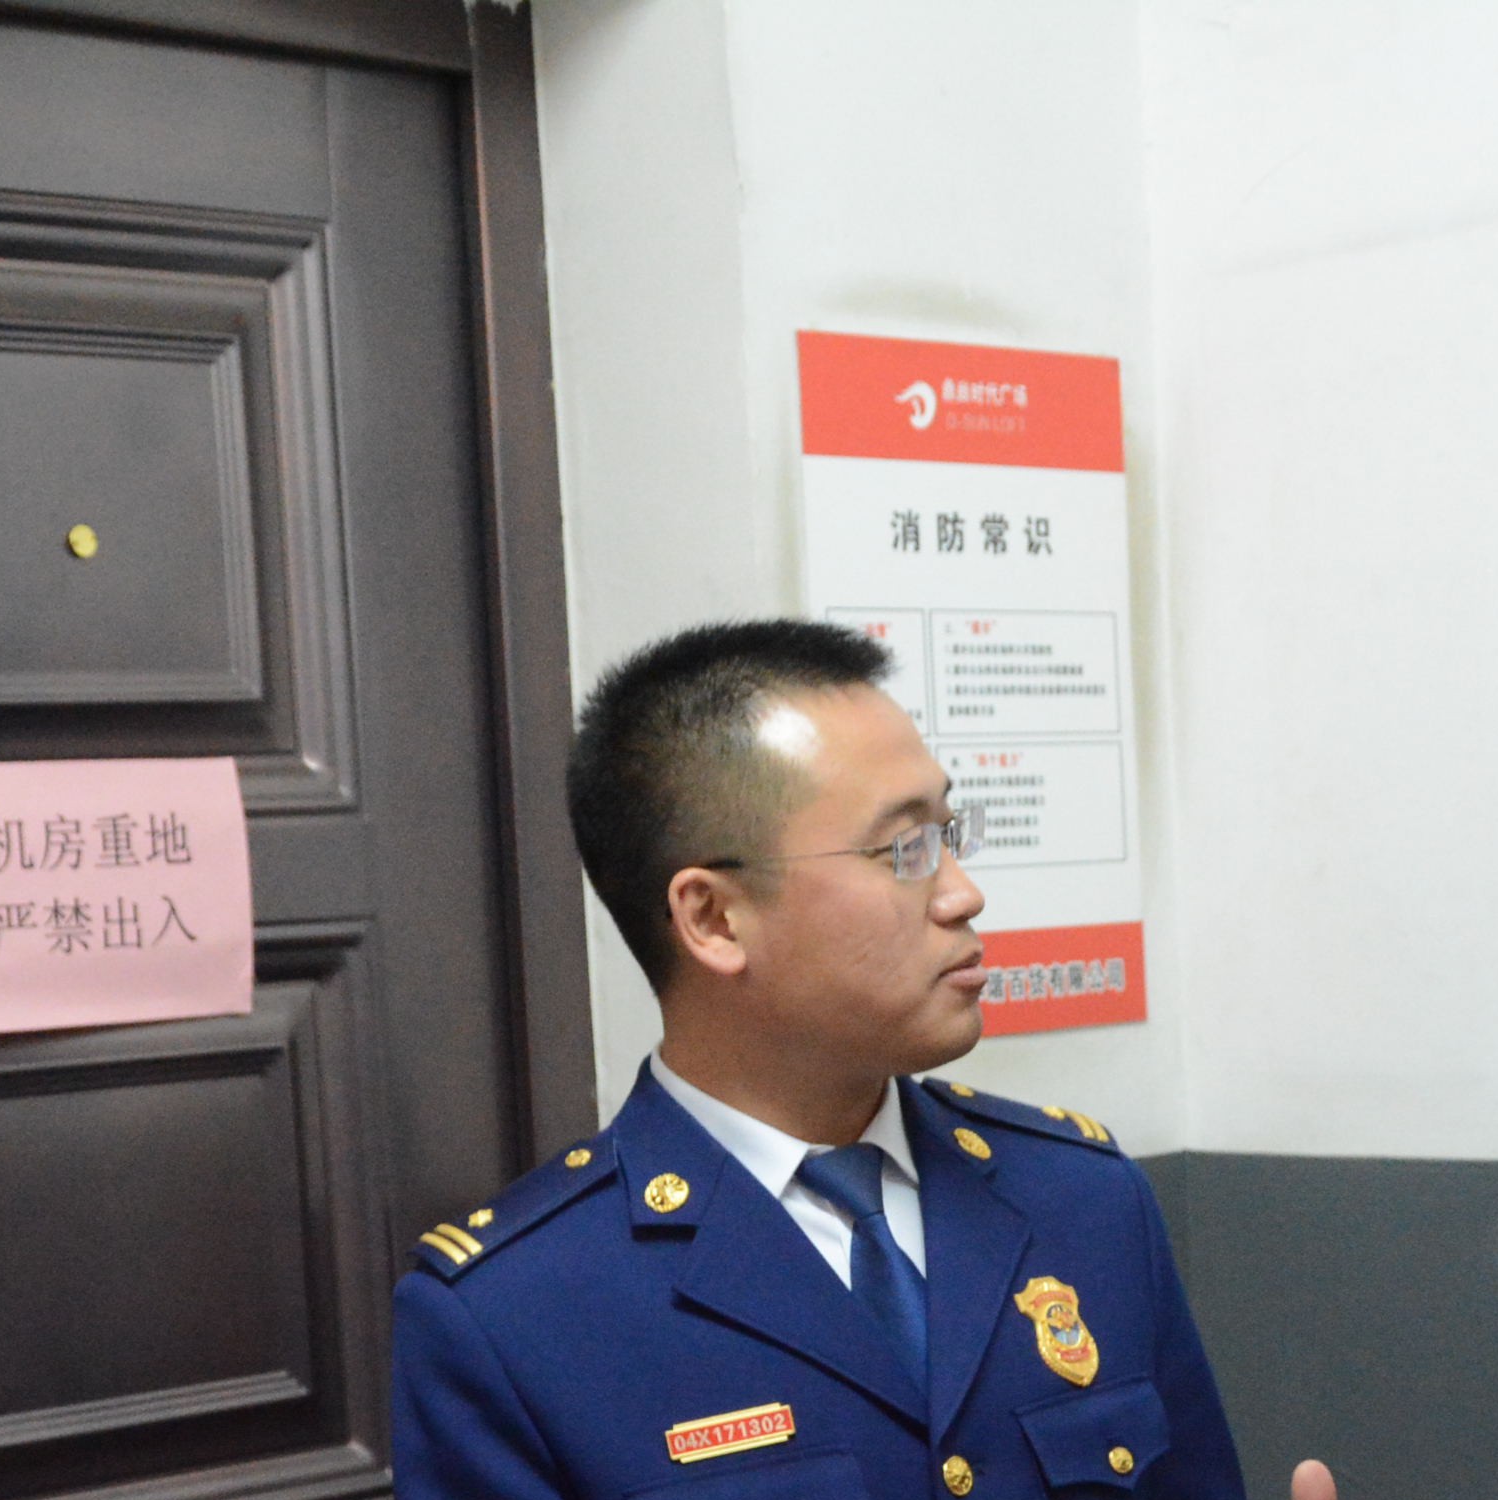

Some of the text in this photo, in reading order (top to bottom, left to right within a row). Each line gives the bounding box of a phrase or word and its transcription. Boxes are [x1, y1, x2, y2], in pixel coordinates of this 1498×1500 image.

[890, 509, 1054, 555] 消防常识
[980, 957, 1126, 1004] 百货有限公司
[673, 1412, 788, 1452] 04X171302
